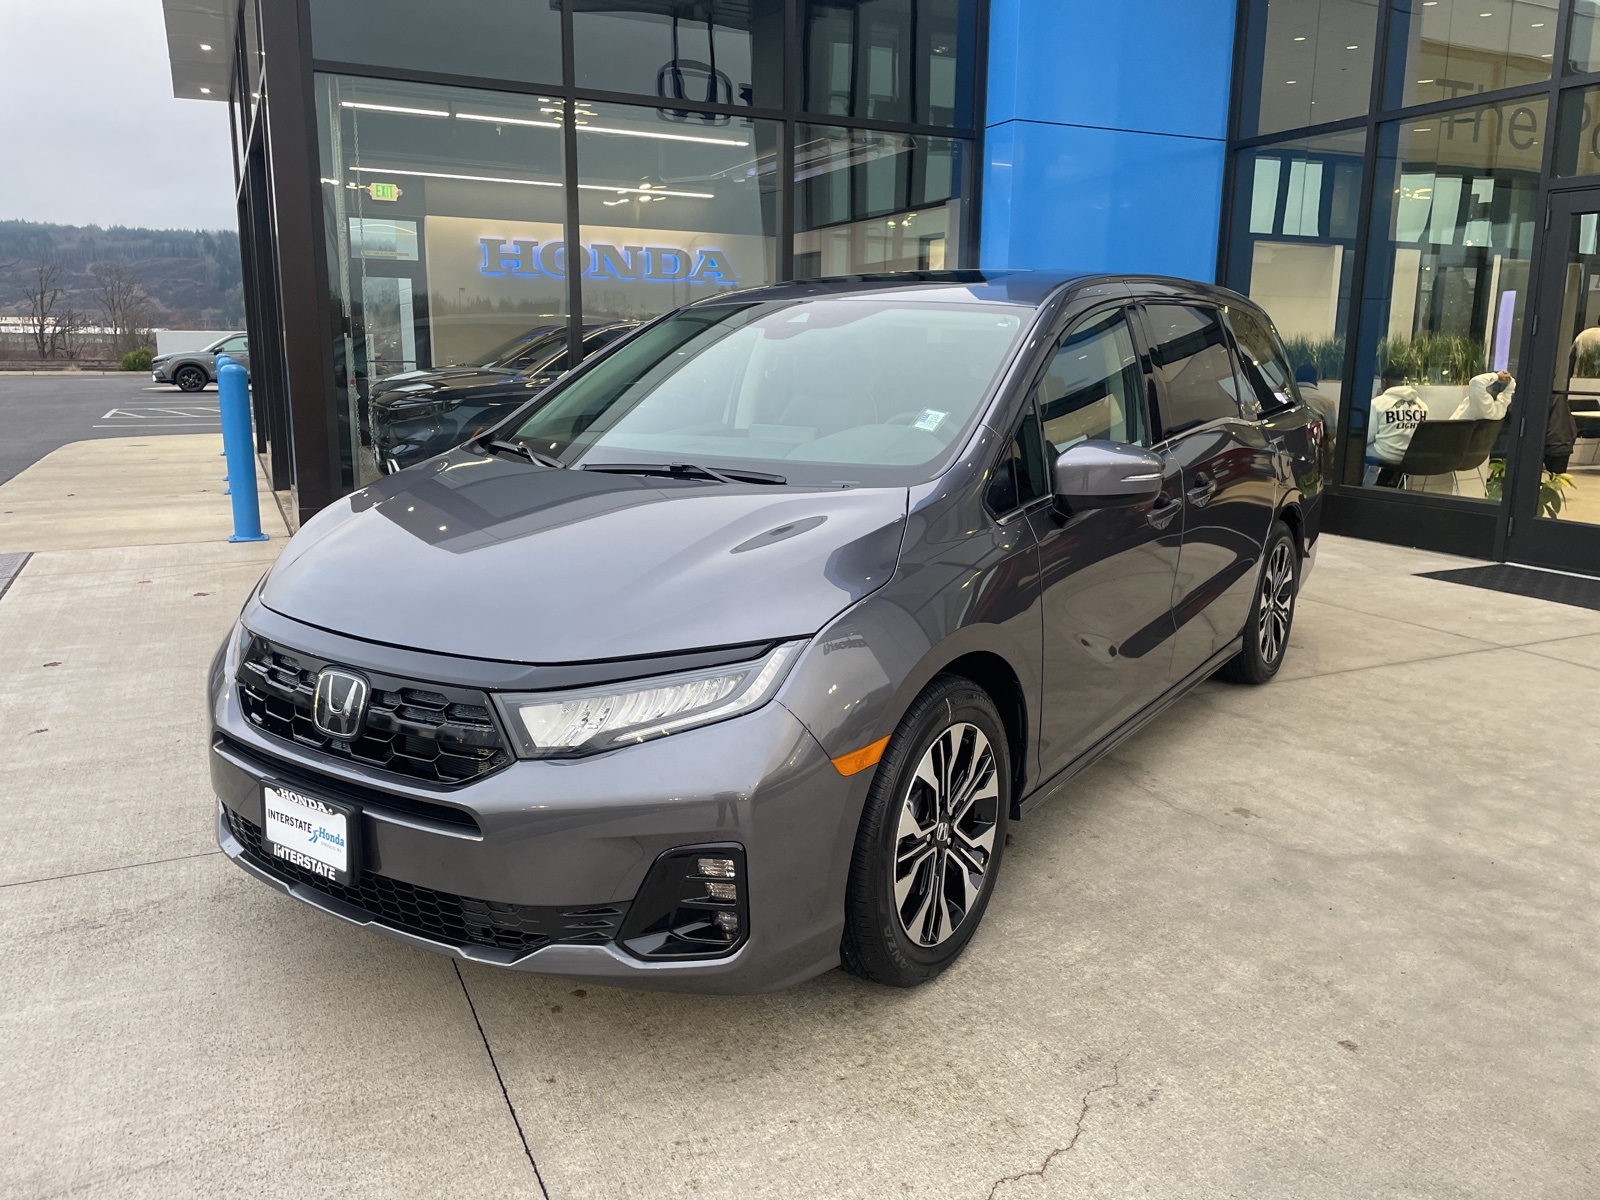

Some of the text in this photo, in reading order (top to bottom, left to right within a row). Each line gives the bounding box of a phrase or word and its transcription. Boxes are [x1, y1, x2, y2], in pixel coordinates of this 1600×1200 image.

[1436, 78, 1537, 150] The
[375, 184, 393, 198] EXIT
[479, 238, 740, 284] HONDA
[1385, 409, 1427, 423] BUSCH
[279, 787, 328, 813] HONDA
[267, 808, 313, 834] INTERSTATE
[318, 826, 345, 847] Honda
[273, 843, 336, 881] INTERSTATE
